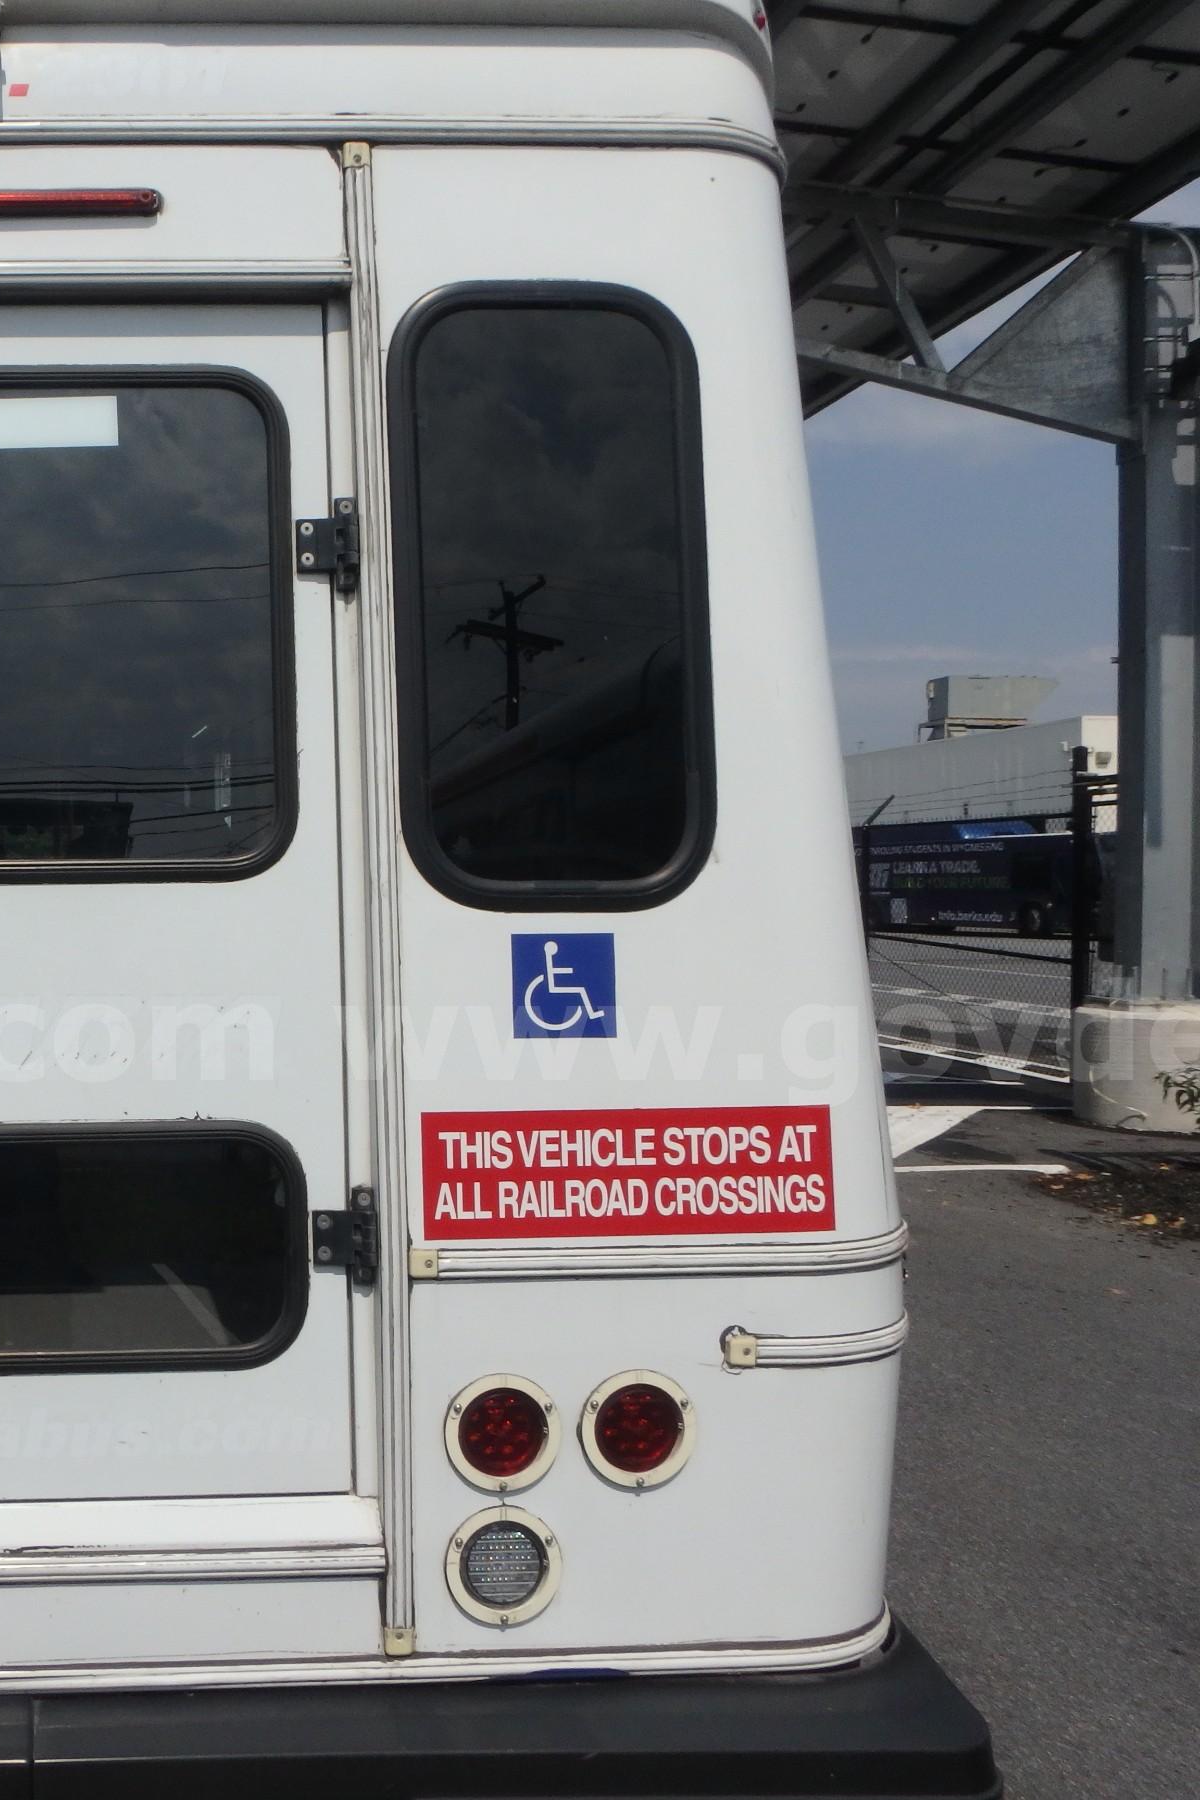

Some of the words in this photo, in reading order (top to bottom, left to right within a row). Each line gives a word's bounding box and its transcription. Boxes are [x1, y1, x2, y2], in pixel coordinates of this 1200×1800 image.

[438, 1131, 513, 1169] THIS
[516, 1128, 657, 1168] VEHICLE
[663, 1126, 772, 1166] STOPS
[778, 1125, 817, 1163] AT
[434, 1181, 493, 1220] ALL
[498, 1178, 649, 1219] RAILROAD
[654, 1174, 826, 1215] CROSSINGS
